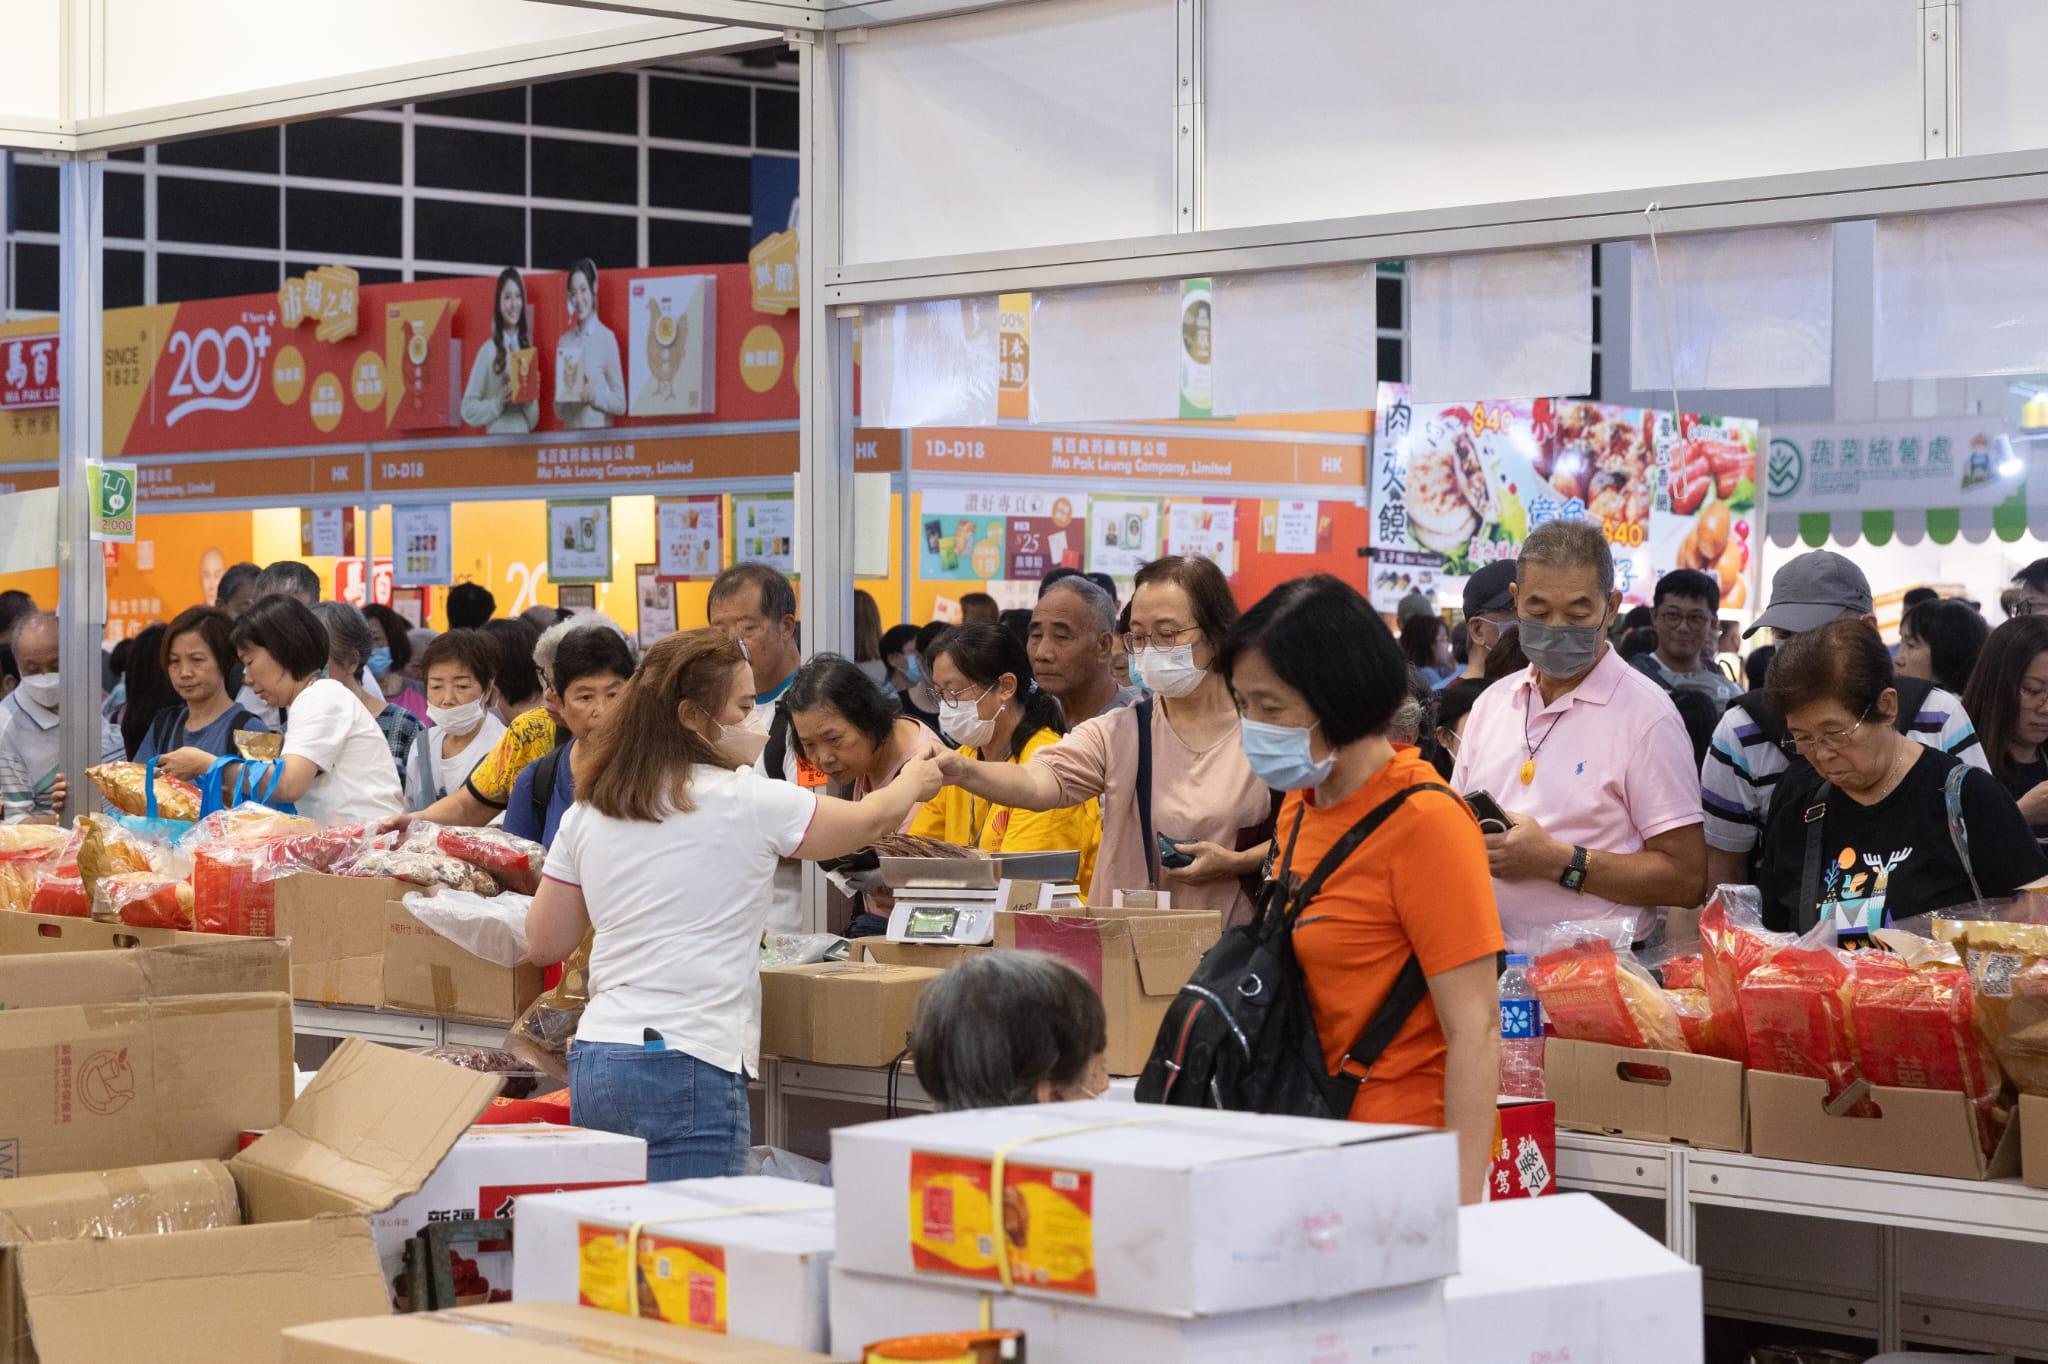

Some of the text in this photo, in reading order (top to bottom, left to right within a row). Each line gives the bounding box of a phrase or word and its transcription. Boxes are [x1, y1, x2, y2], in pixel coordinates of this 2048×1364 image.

[999, 312, 1025, 329] 00%
[5, 341, 59, 389] 馬百
[105, 346, 139, 366] SINCE
[106, 367, 140, 387] 1822
[855, 441, 878, 459] HK
[926, 439, 986, 459] 1D-D18
[331, 466, 348, 482] HK
[1052, 456, 1071, 470] Ma
[1073, 457, 1096, 472] Pak
[1097, 458, 1133, 476] Leung
[1191, 461, 1232, 476] Limited
[1321, 456, 1343, 473] HK
